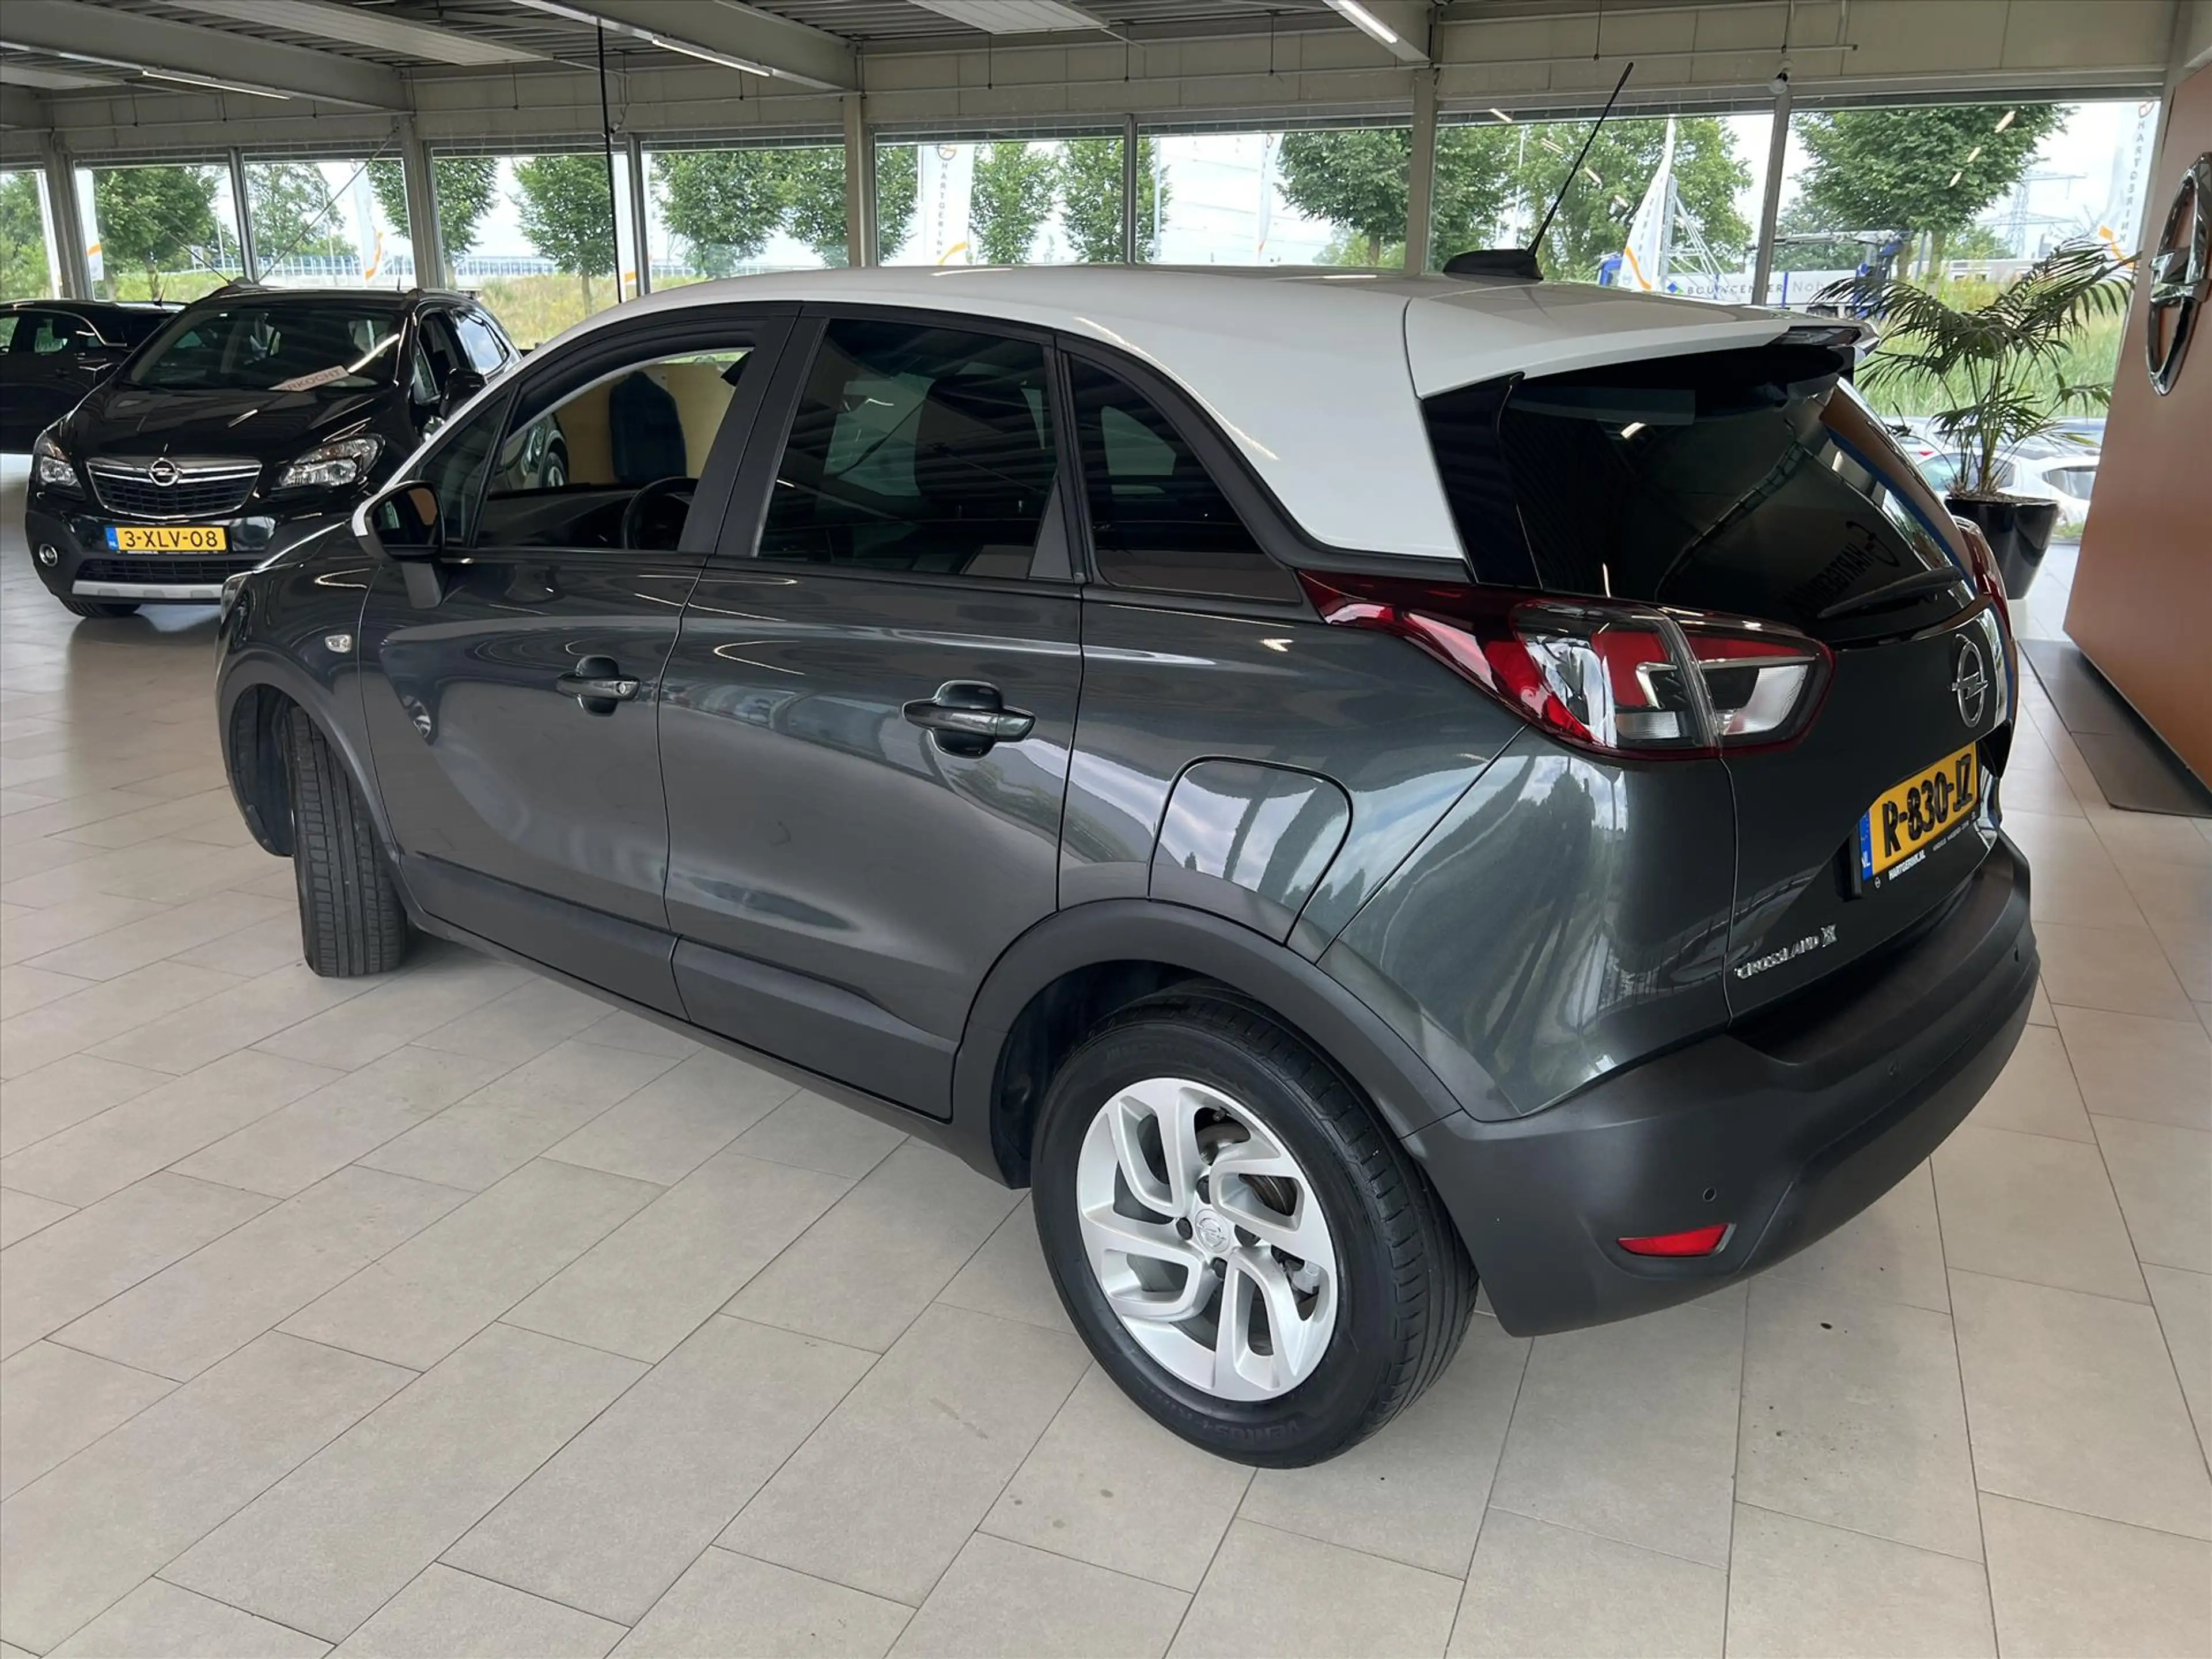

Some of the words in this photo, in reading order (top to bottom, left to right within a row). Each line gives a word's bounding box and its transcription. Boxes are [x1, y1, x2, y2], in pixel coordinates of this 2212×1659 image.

[1688, 284, 1784, 294] BOUWCENER
[282, 368, 341, 391] RKOCHT
[124, 531, 218, 547] 3-XLV-08
[1882, 753, 1973, 858] R-830-JZ
[1734, 936, 1819, 979] CROSSLAND
[1821, 924, 1838, 948] X
